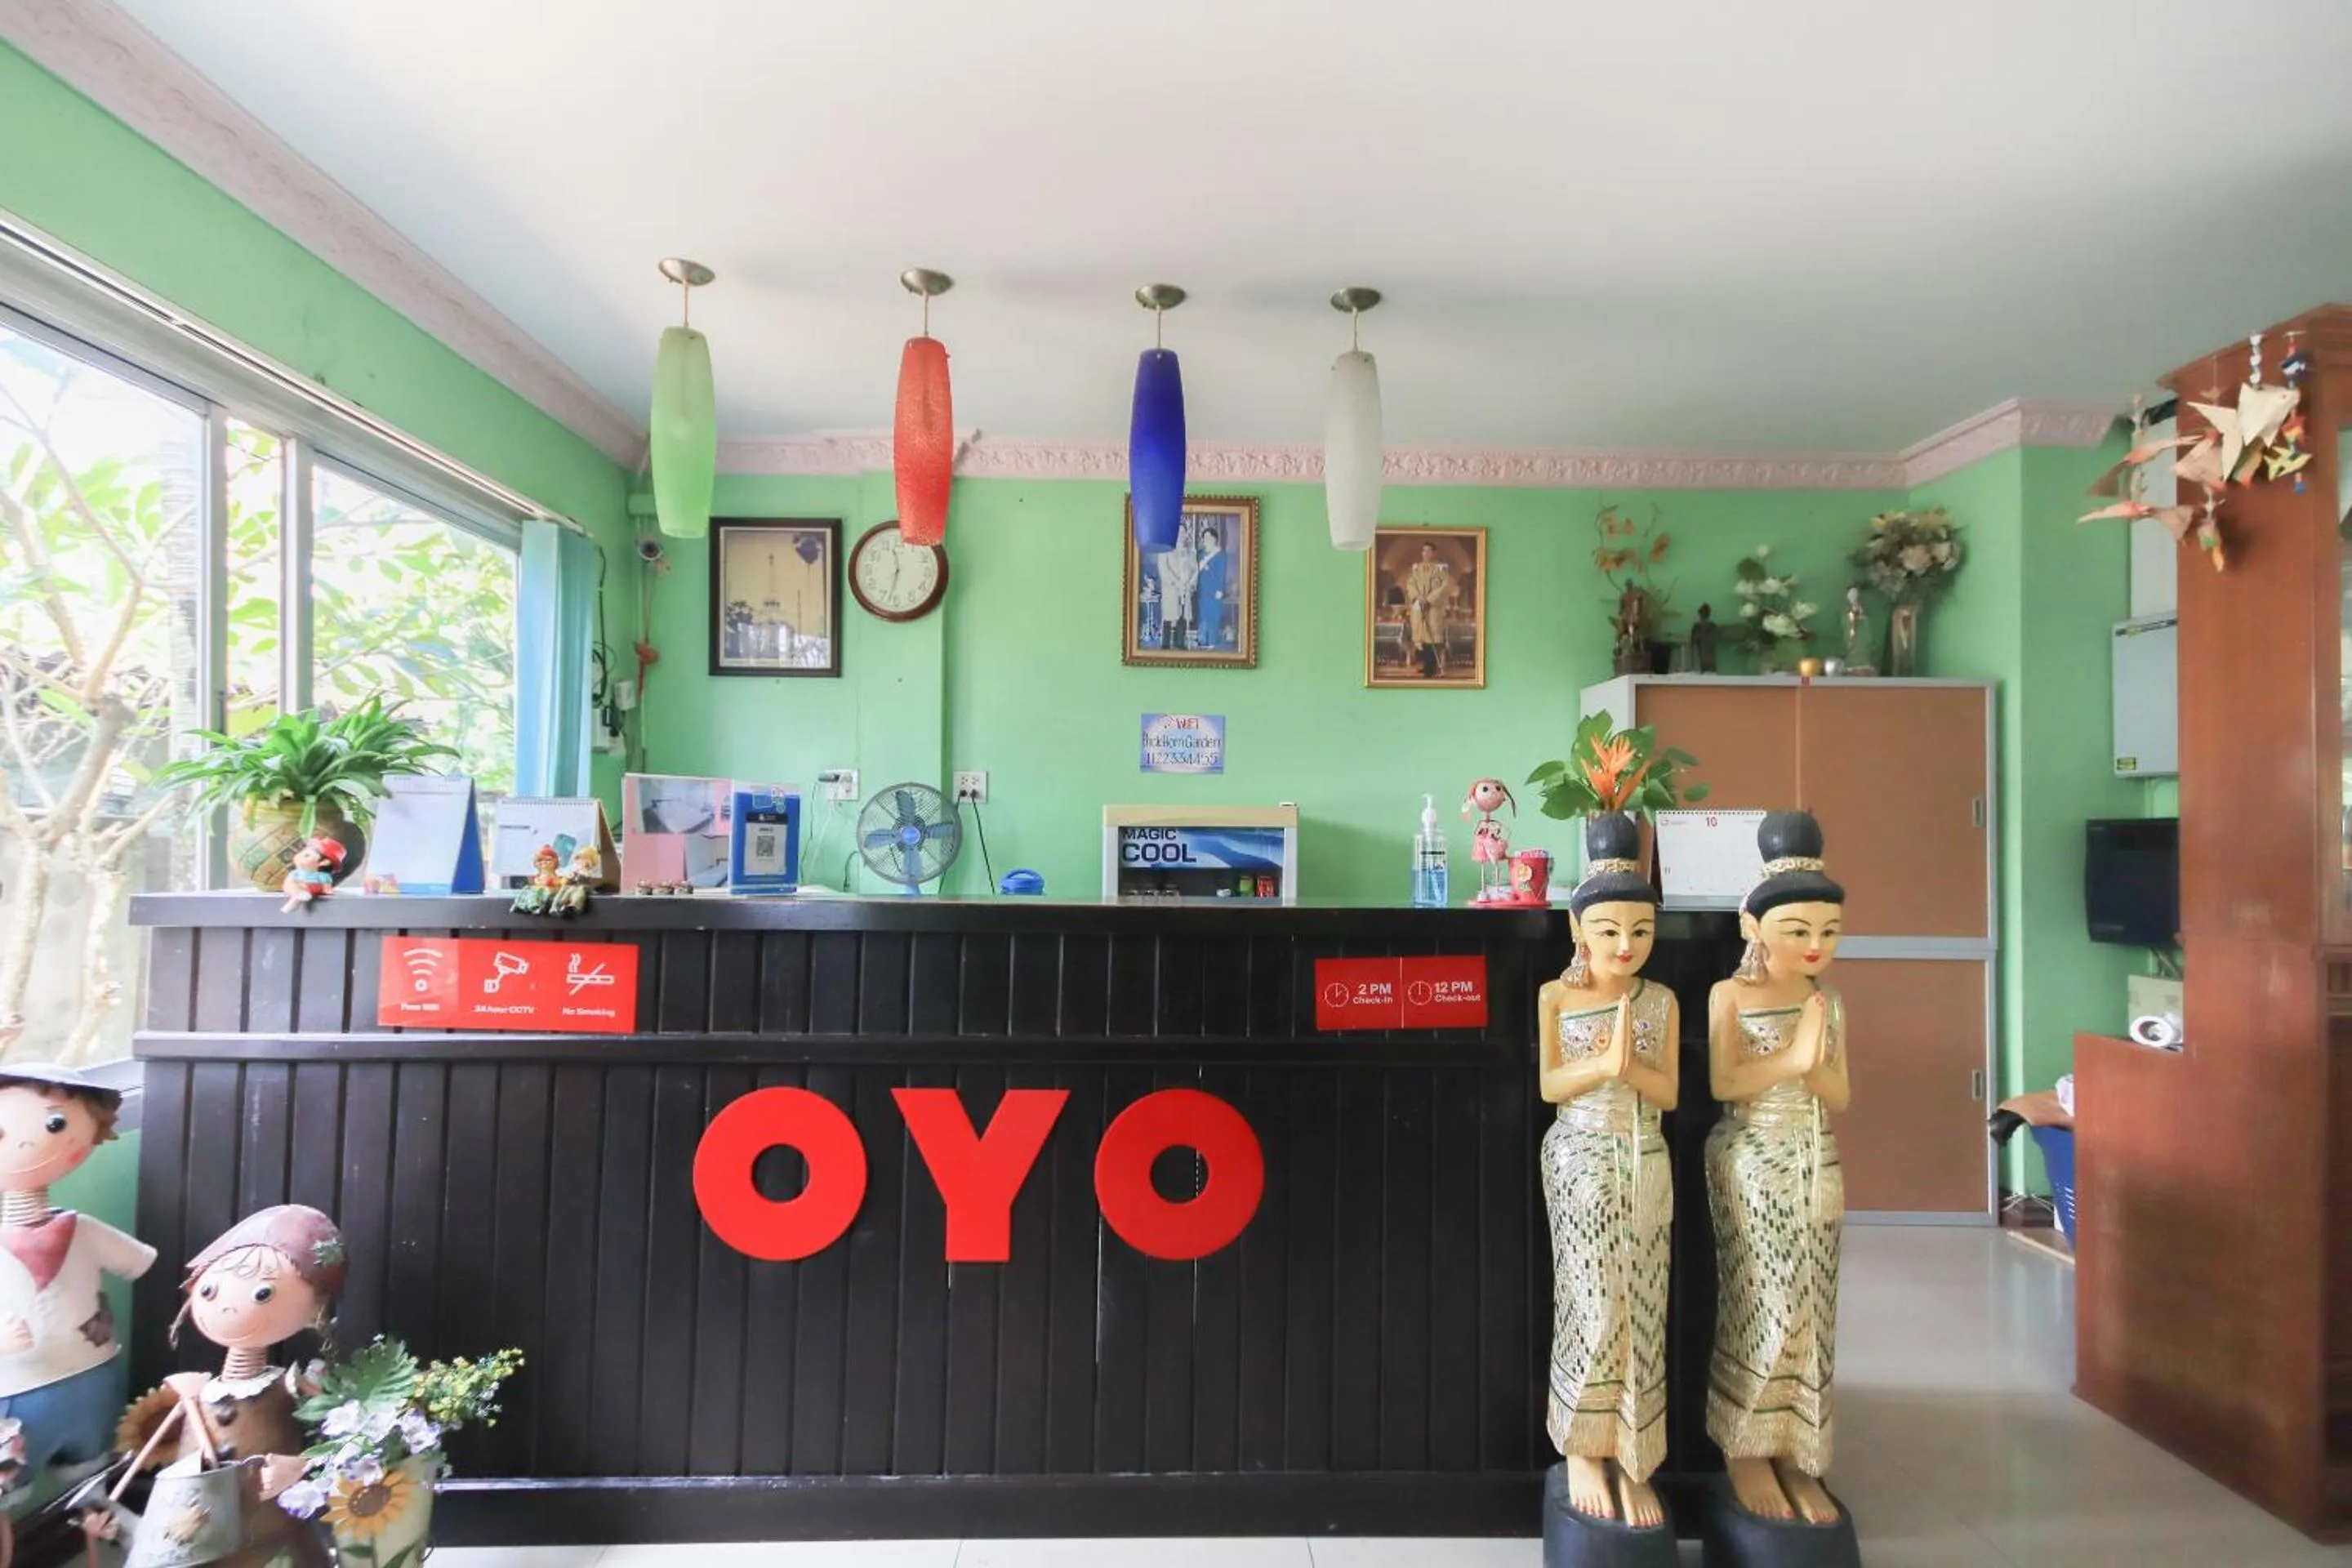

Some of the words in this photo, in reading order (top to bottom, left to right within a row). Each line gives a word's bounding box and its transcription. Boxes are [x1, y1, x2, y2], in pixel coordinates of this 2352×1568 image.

[1706, 816, 1718, 827] 10
[1123, 829, 1177, 840] MAGIC
[1122, 843, 1197, 862] COOL
[1358, 984, 1366, 996] 2
[1370, 982, 1392, 995] PM
[1434, 982, 1448, 994] 12
[1451, 980, 1473, 992] PM
[1352, 995, 1393, 1005] Check-in
[1434, 993, 1481, 1003] Check-out
[693, 1086, 1265, 1263] OYO
